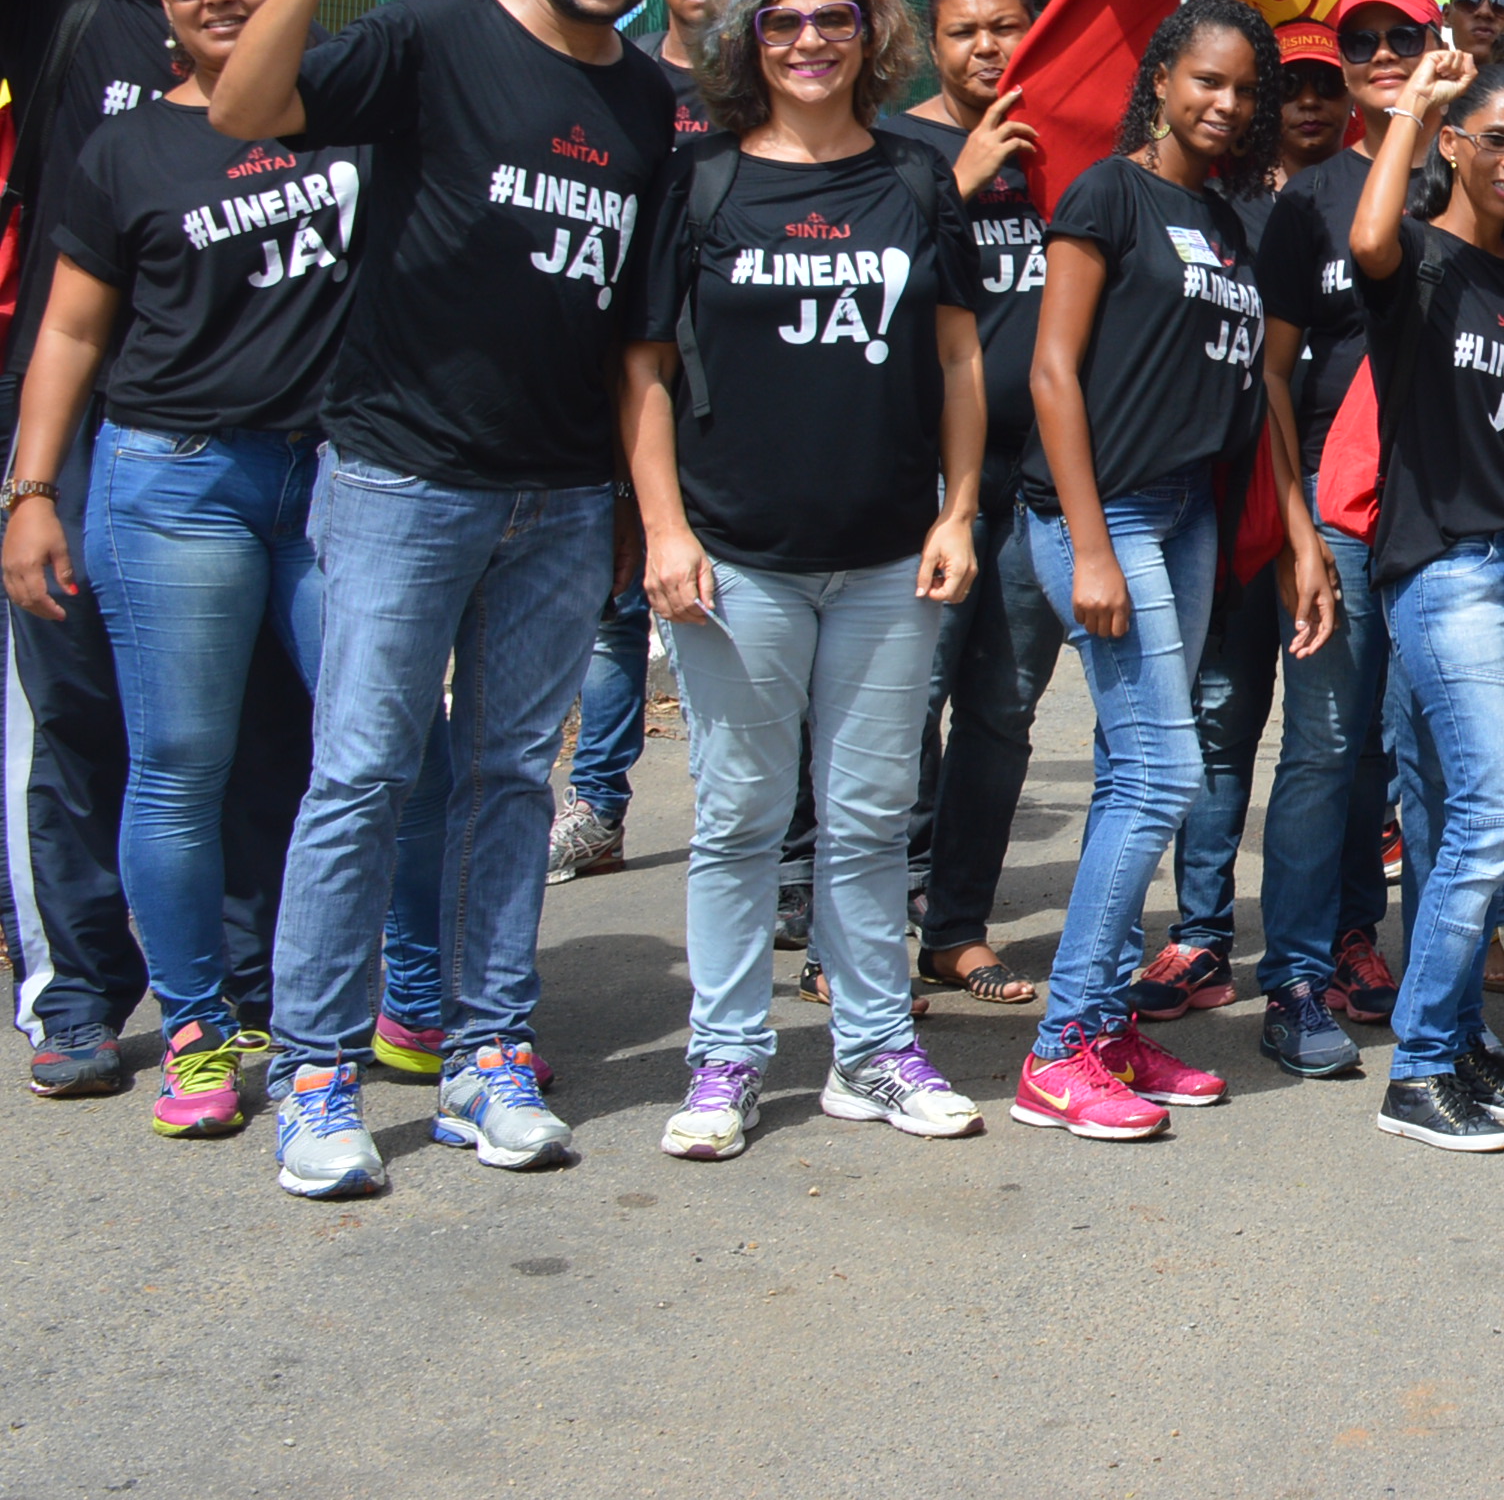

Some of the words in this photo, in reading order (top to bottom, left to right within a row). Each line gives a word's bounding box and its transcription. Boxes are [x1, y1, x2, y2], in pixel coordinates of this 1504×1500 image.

[1290, 33, 1335, 49] SINTAJ
[226, 153, 297, 180] SINTAJ
[551, 136, 610, 168] SINTAJ
[183, 172, 338, 251] #LINEAR
[489, 163, 624, 231] #LINEAR
[784, 222, 852, 241] SINTAJ
[972, 217, 1048, 246] INEA
[730, 247, 884, 287] #LINEAR
[1183, 263, 1263, 319] #LINEAR
